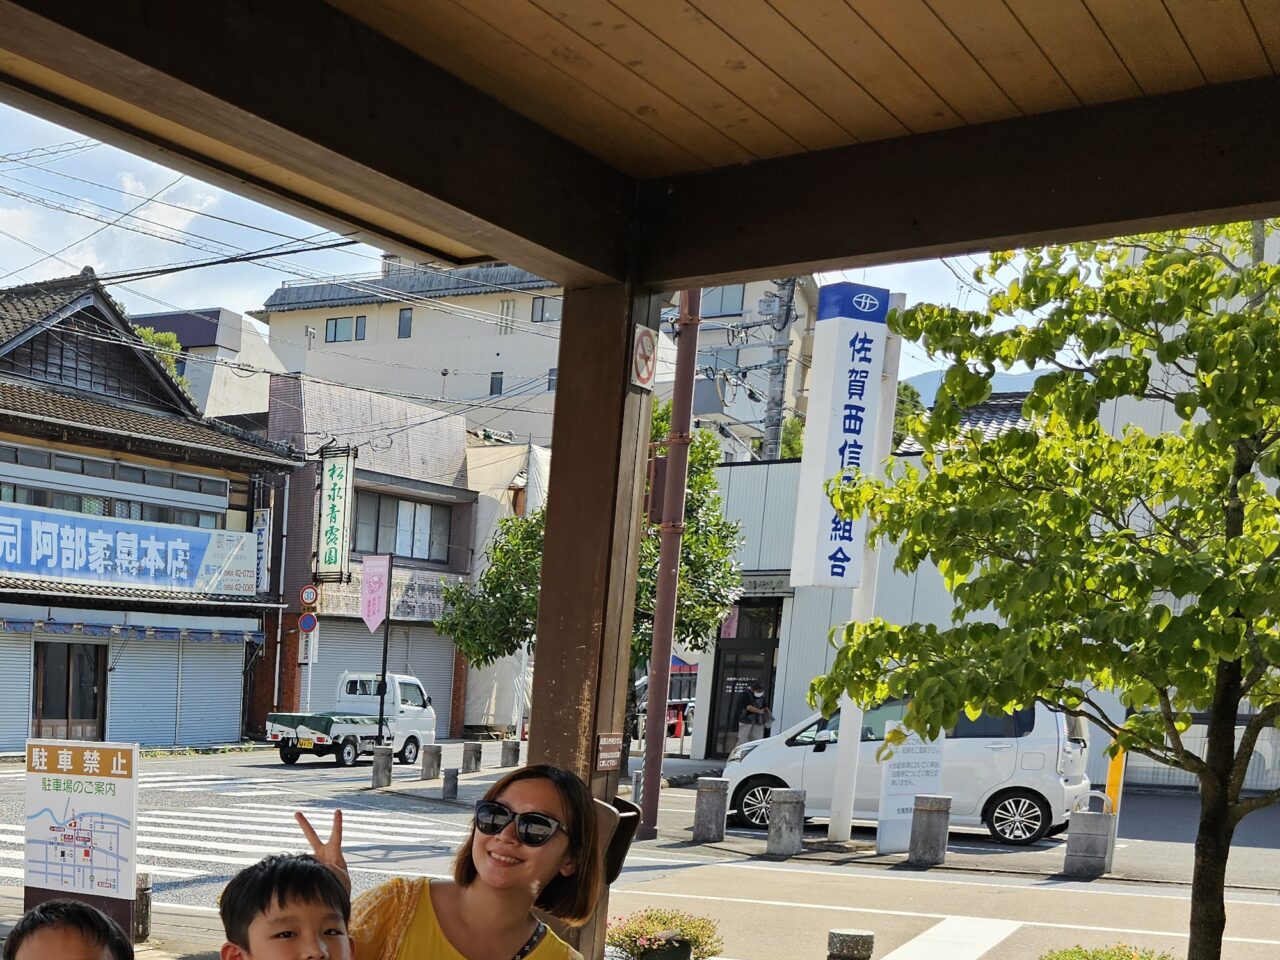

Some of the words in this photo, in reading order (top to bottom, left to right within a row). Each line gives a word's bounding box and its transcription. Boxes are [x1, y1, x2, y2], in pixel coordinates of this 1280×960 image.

[827, 331, 874, 578] 佐賀西信組合
[30, 519, 190, 580] 阿部家具本店
[32, 747, 128, 775] 駐車禁止
[42, 777, 116, 796] 駐車場のご案内
